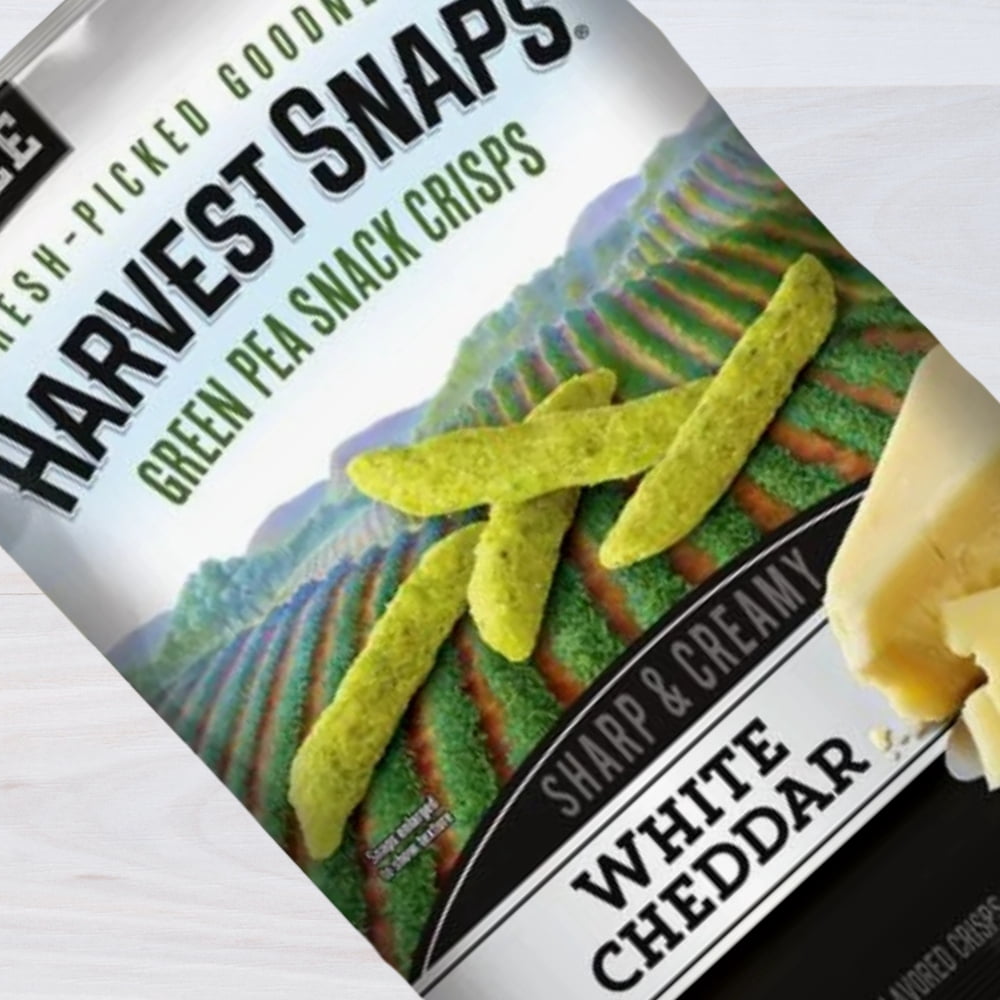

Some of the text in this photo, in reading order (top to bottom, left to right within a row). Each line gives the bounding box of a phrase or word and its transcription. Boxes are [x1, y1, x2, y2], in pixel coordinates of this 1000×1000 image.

[217, 0, 377, 100] GOODN
[137, 122, 546, 505] GREEN PEA SNACK CRISPS
[541, 547, 823, 818] SHARP & CREAMY
[572, 717, 790, 910] WHITE
[591, 737, 870, 992] CHEDDAR
